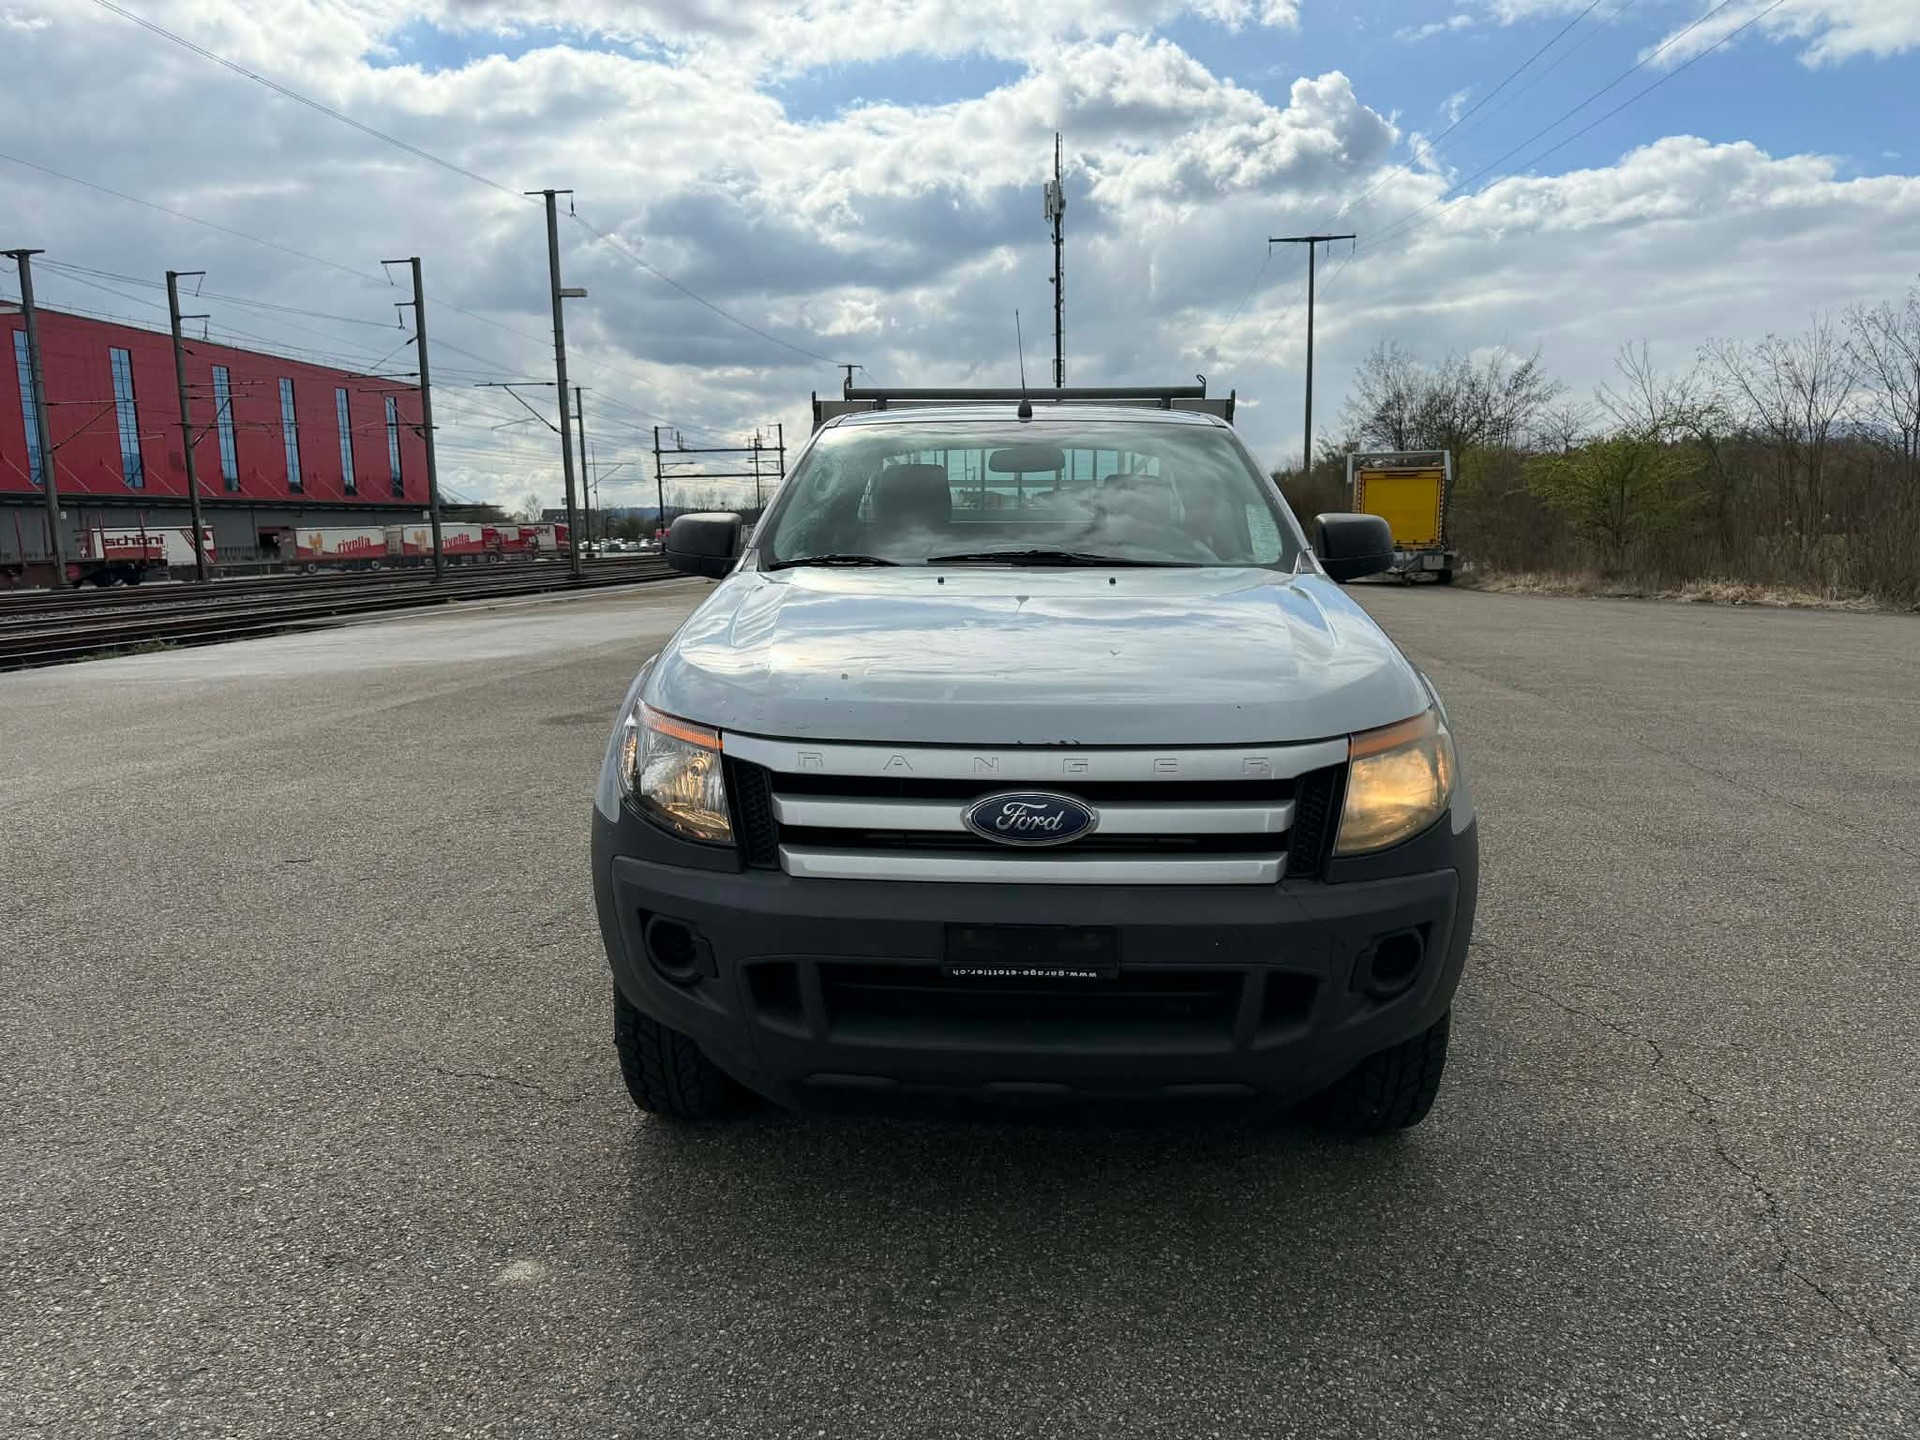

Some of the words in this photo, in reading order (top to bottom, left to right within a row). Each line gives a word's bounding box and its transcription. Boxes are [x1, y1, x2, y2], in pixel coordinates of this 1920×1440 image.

[337, 535, 370, 553] rivella
[797, 751, 1270, 774] RANGER
[995, 801, 1065, 831] Ford
